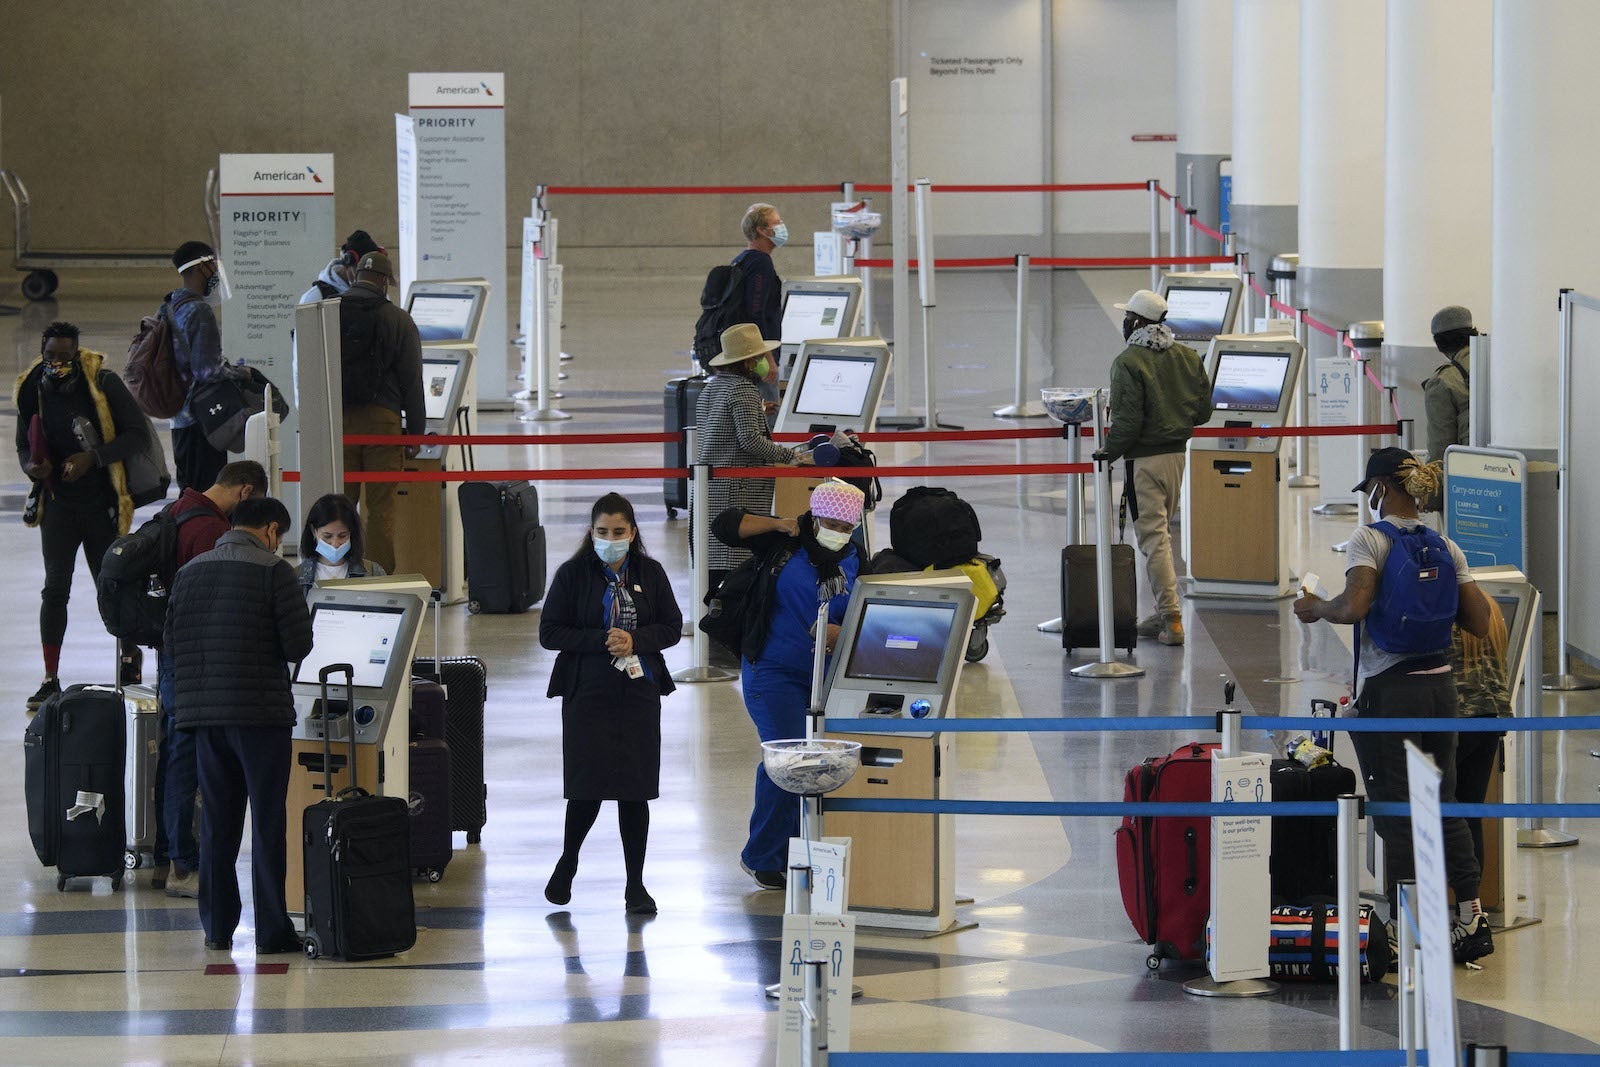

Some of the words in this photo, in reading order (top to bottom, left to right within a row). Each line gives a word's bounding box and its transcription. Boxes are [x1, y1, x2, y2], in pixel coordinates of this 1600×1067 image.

[930, 57, 961, 65] Ticketed
[963, 57, 1004, 66] Passengers
[1005, 56, 1023, 66] Only
[929, 67, 958, 77] Beyond
[960, 67, 975, 75] This
[976, 67, 996, 75] Point
[436, 86, 480, 95] American
[418, 118, 476, 128] PRIORITY
[253, 171, 305, 181] American
[233, 211, 301, 222] PRIORITY
[264, 269, 294, 277] Economy
[1483, 463, 1509, 474] American
[1451, 484, 1476, 497] Carry-on
[1484, 488, 1502, 498] check?
[1235, 818, 1261, 826] well-being
[815, 919, 838, 927] American
[1273, 963, 1311, 977] PINK
[787, 985, 803, 994] Your
[786, 994, 793, 1002] is
